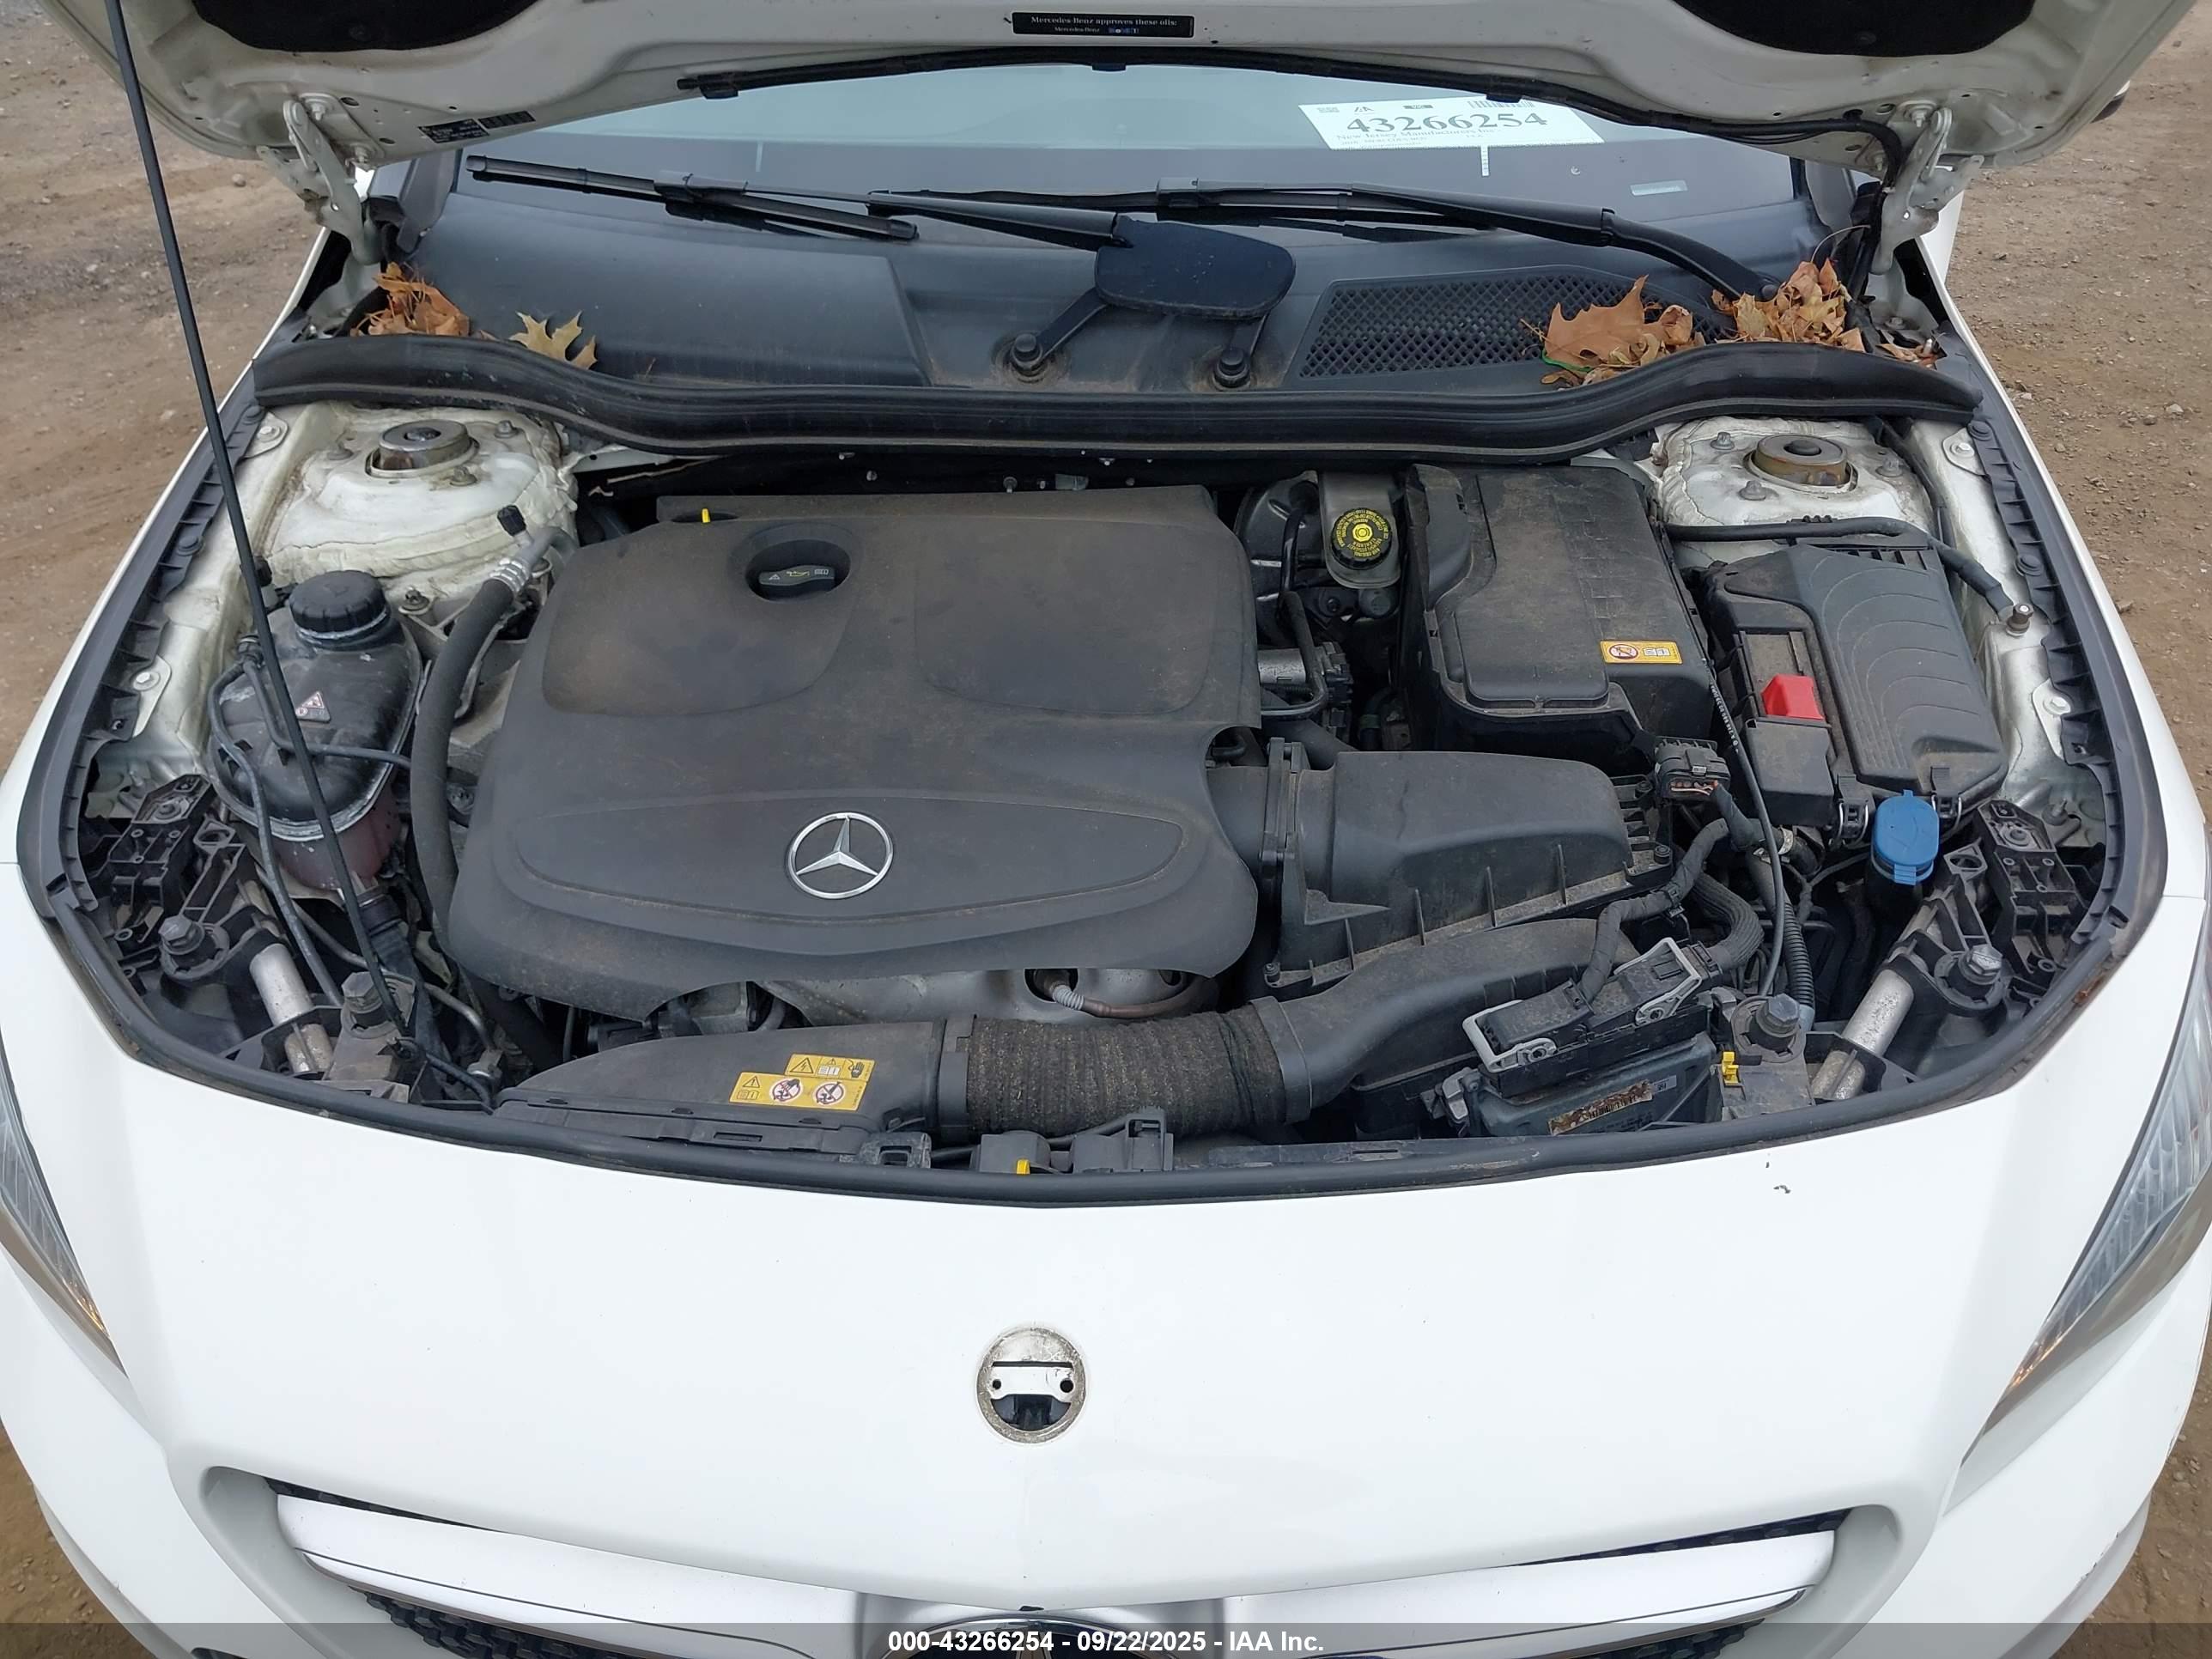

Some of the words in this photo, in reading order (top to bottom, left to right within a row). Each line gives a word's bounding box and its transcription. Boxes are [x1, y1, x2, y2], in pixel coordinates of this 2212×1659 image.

[1031, 16, 1094, 25] Mercedes-Benz
[1095, 18, 1133, 27] approves
[1346, 112, 1549, 133] 43266254
